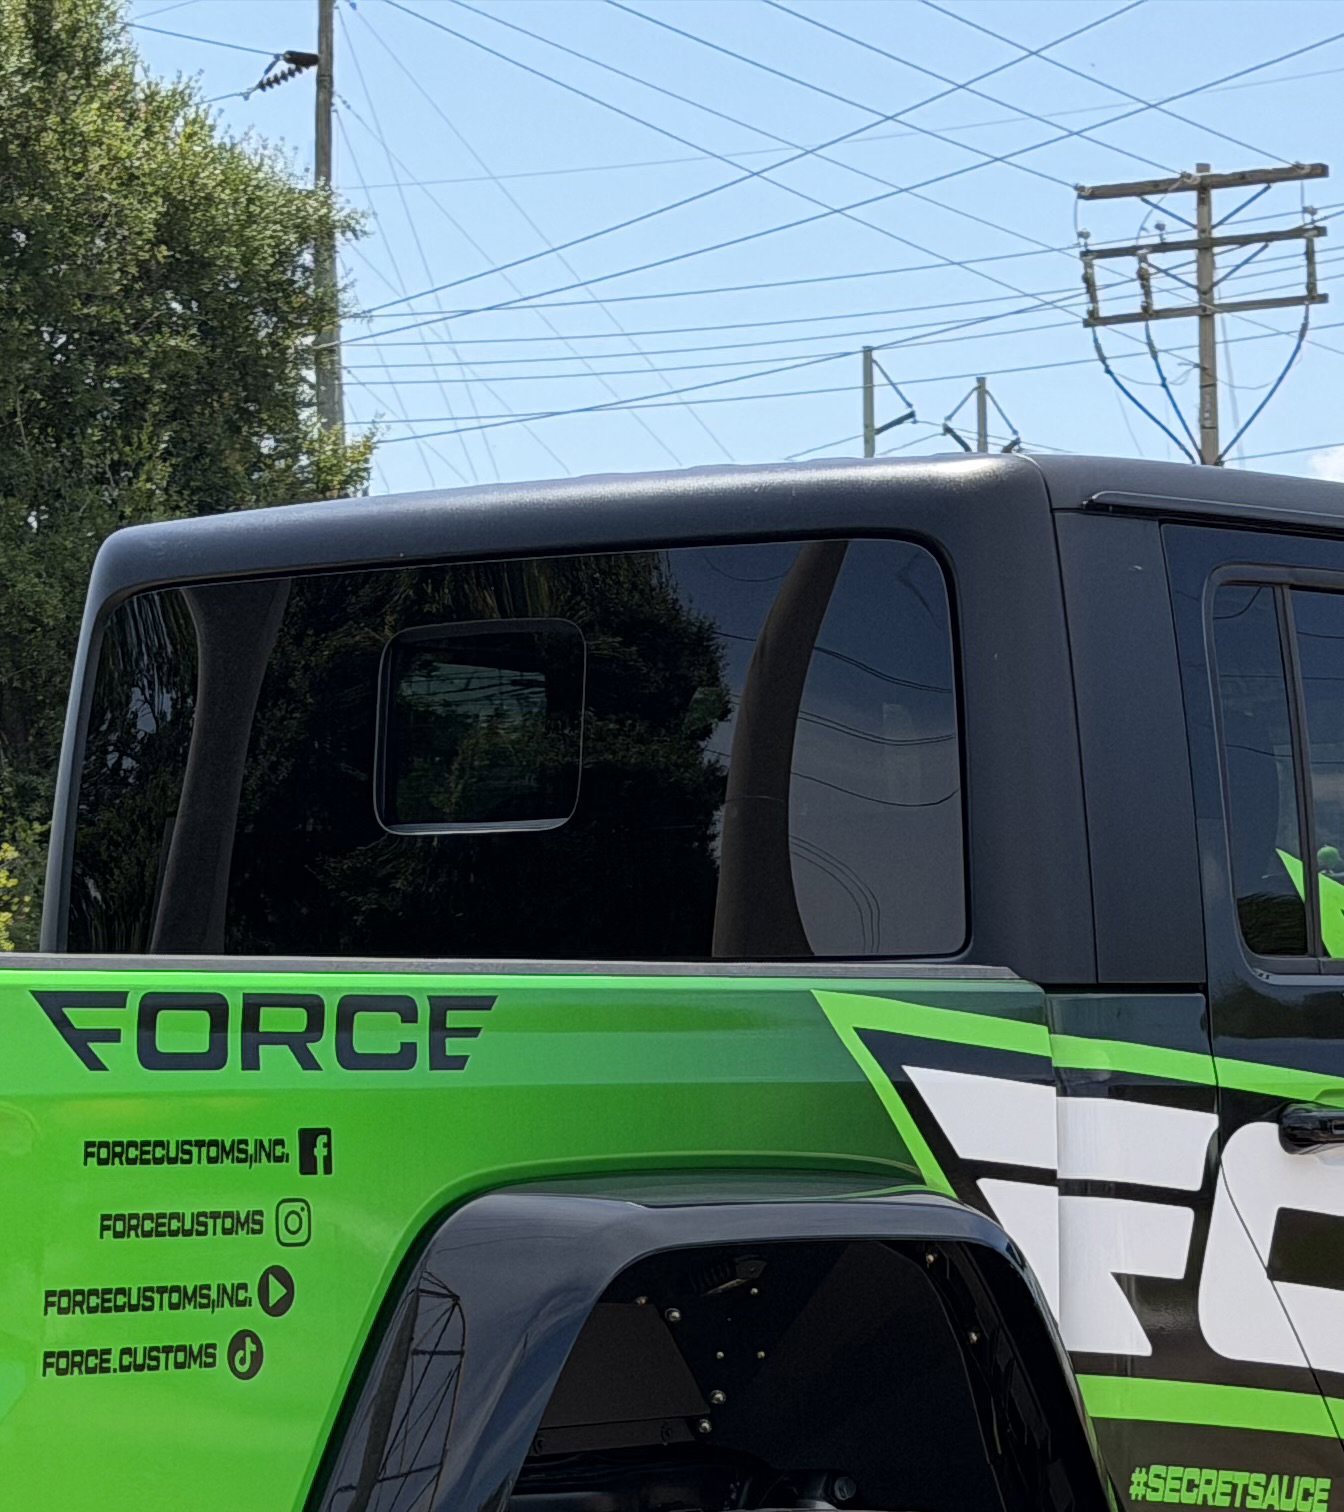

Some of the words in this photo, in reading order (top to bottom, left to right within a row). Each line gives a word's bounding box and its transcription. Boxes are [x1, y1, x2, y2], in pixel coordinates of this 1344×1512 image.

[29, 989, 500, 1072] FORCE
[99, 1210, 264, 1240] FORCECUSTOMS
[42, 1342, 217, 1377] FORCE.CUSTOMS
